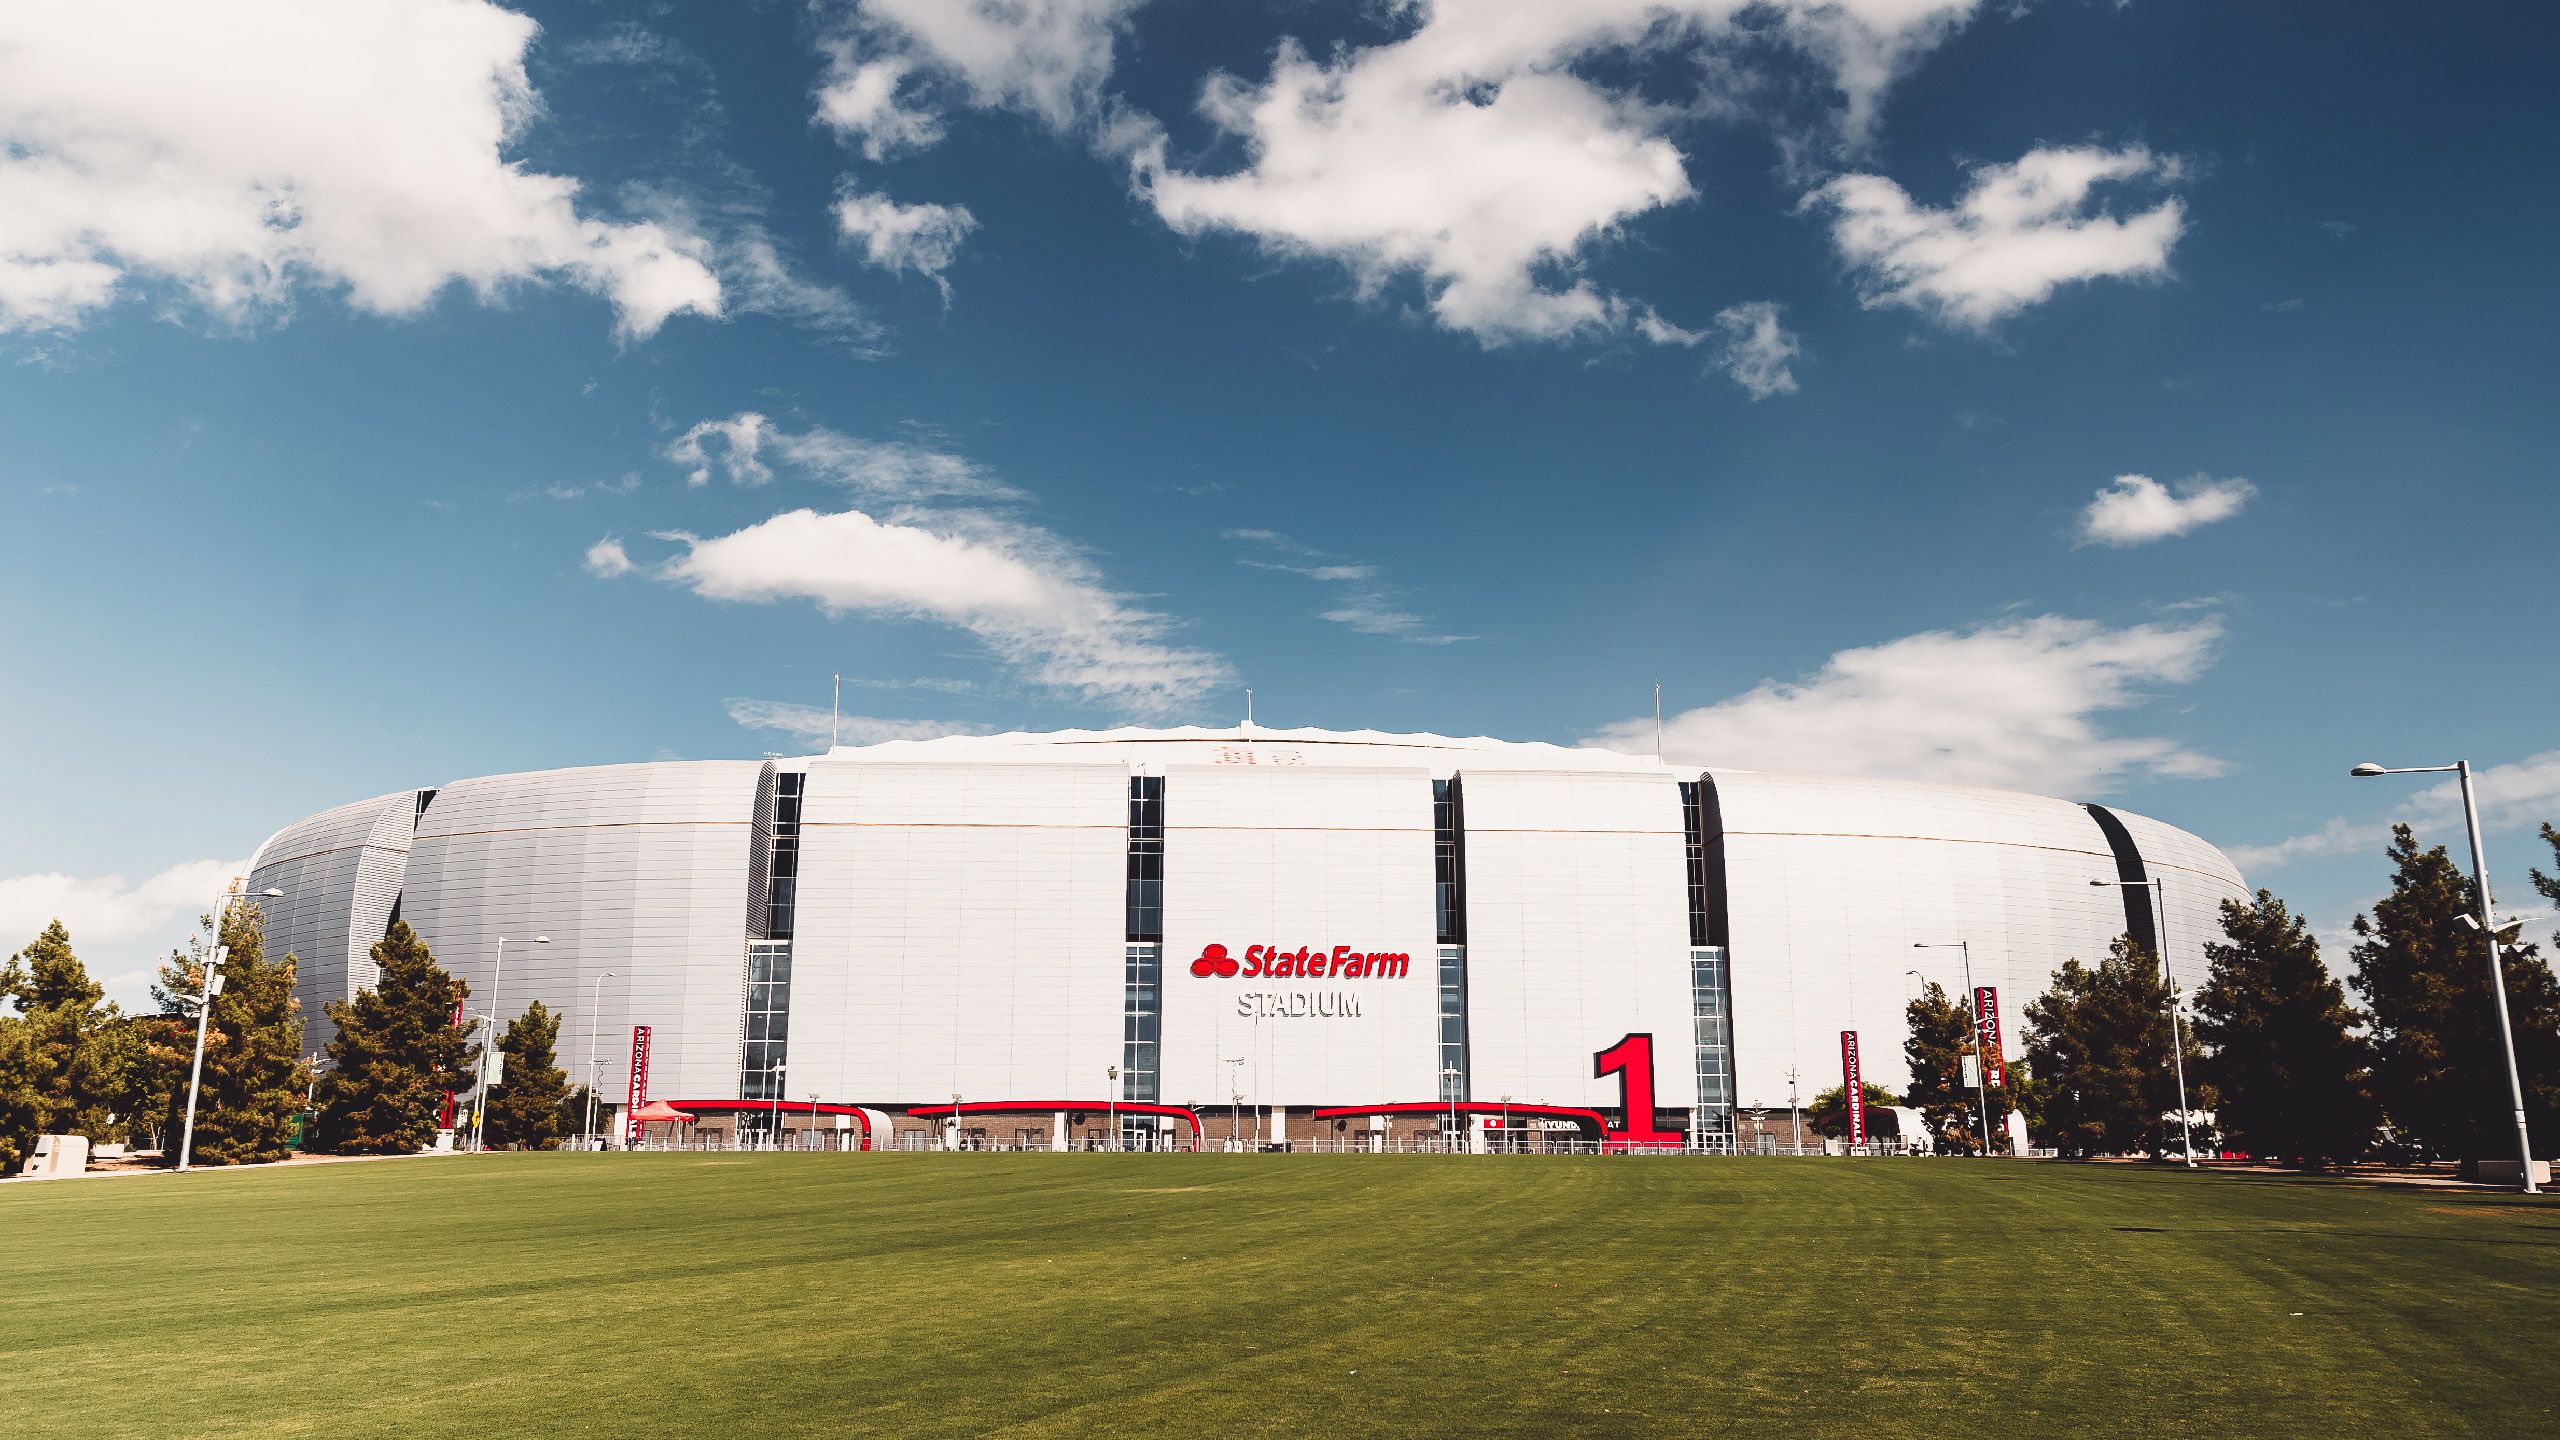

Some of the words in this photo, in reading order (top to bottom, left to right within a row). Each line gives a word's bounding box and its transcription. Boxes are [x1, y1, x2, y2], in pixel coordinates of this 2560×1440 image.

[1237, 990, 1364, 1017] STADIUM
[1982, 989, 1998, 1047] ARIZONA
[633, 1027, 645, 1074] ARIZONA
[1846, 1032, 1858, 1079] ARIZONA
[1593, 1033, 1690, 1152] 1
[1850, 1079, 1863, 1145] CARDINALS
